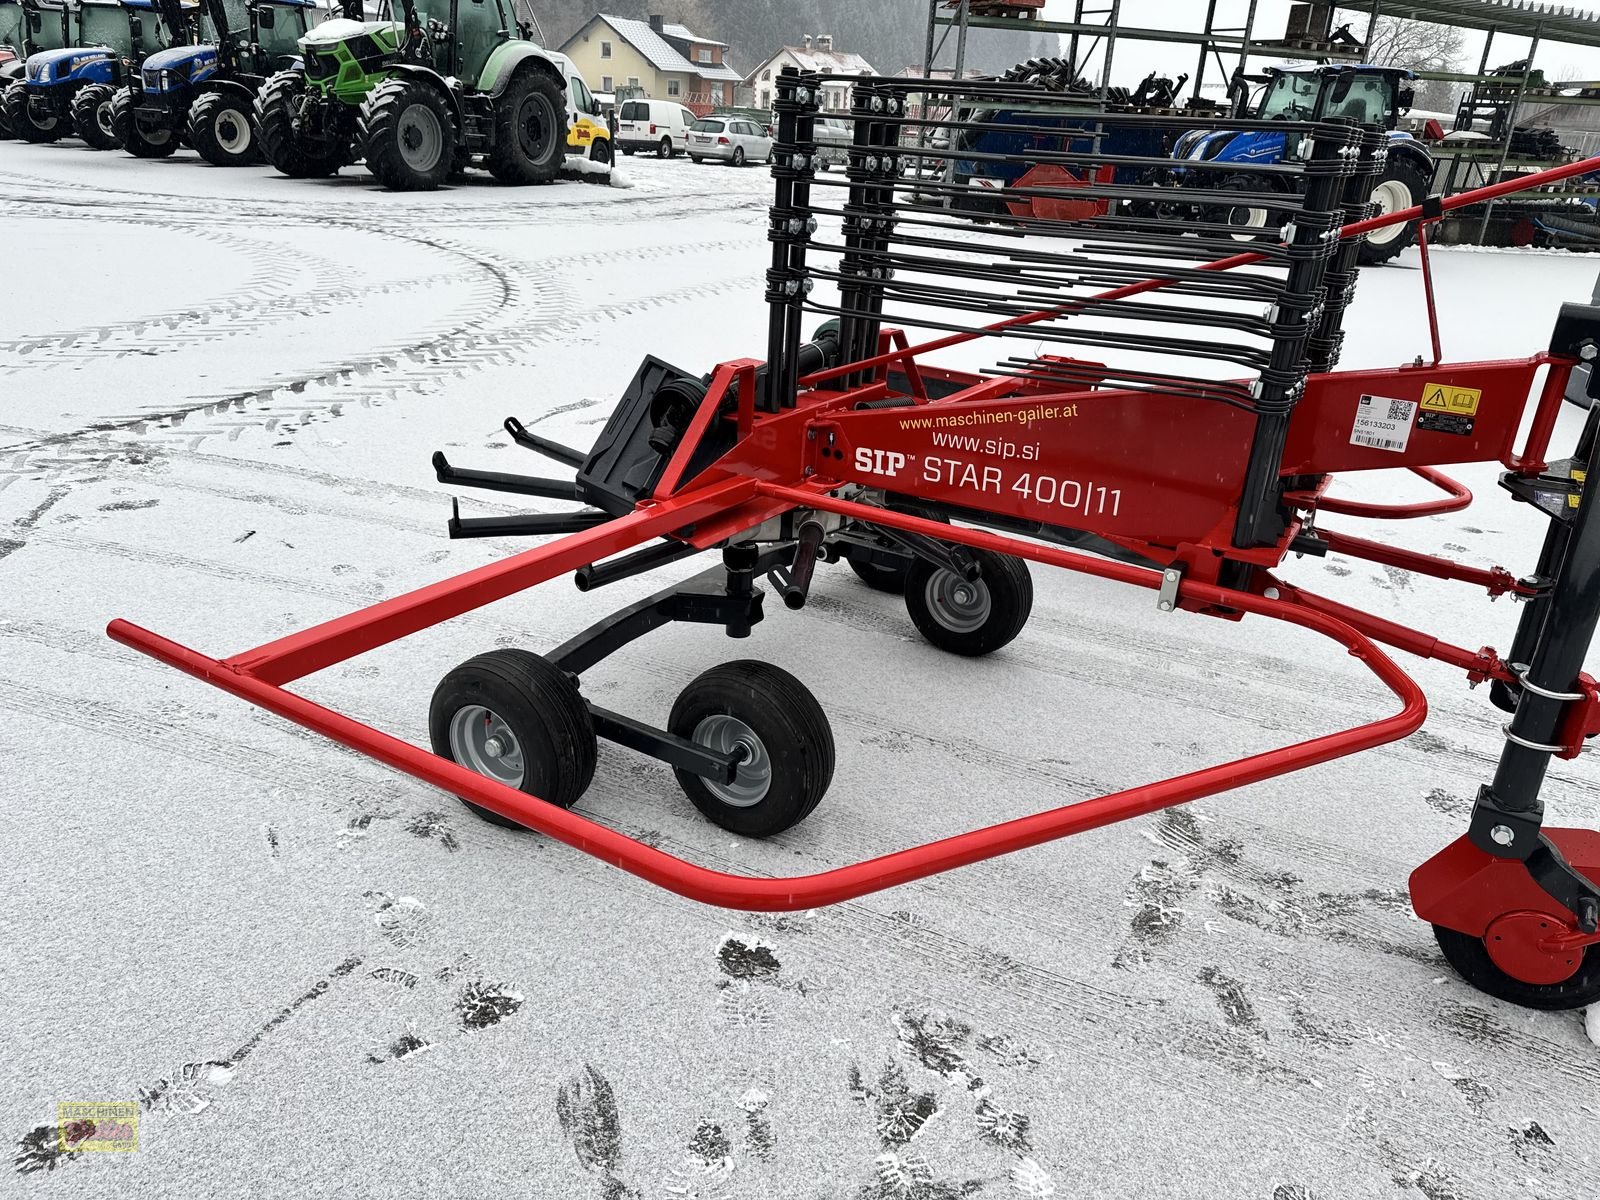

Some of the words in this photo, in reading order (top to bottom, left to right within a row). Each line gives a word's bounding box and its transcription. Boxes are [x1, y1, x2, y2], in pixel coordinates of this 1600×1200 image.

[899, 403, 1078, 430] www.maschinen-gailer.at
[1356, 418, 1396, 430] 156133203
[932, 431, 1040, 461] www.sip.si
[923, 456, 1002, 494] STAR
[1011, 473, 1121, 516] 400|11
